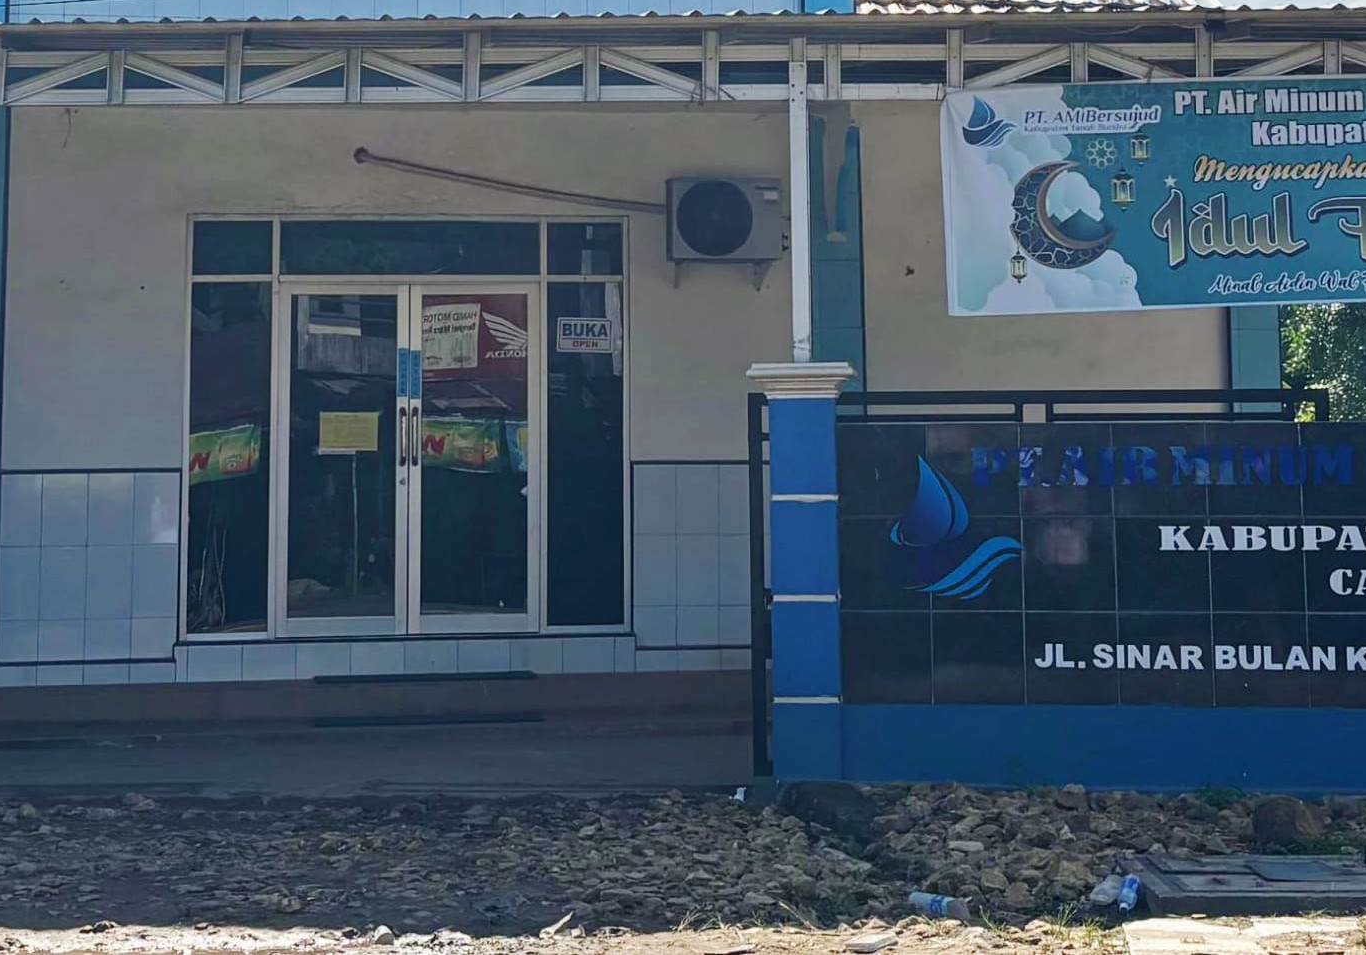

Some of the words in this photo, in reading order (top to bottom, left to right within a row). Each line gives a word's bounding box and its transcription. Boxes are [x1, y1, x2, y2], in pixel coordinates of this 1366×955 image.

[1174, 89, 1212, 115] PT.
[1217, 88, 1258, 114] Air
[1264, 87, 1364, 113] Minum
[1024, 110, 1048, 124] PT.
[1151, 188, 1309, 267] Idul
[1208, 272, 1263, 294] Minal
[1264, 273, 1317, 293] Aidin
[1318, 270, 1358, 293] Wal
[562, 323, 608, 337] BUKA
[572, 340, 599, 348] OPEN
[1056, 445, 1159, 487] AIR
[1169, 445, 1356, 486] MINUM
[1035, 643, 1087, 669] JL.
[1092, 643, 1205, 671] SINAR
[1215, 644, 1337, 671] BULAN
